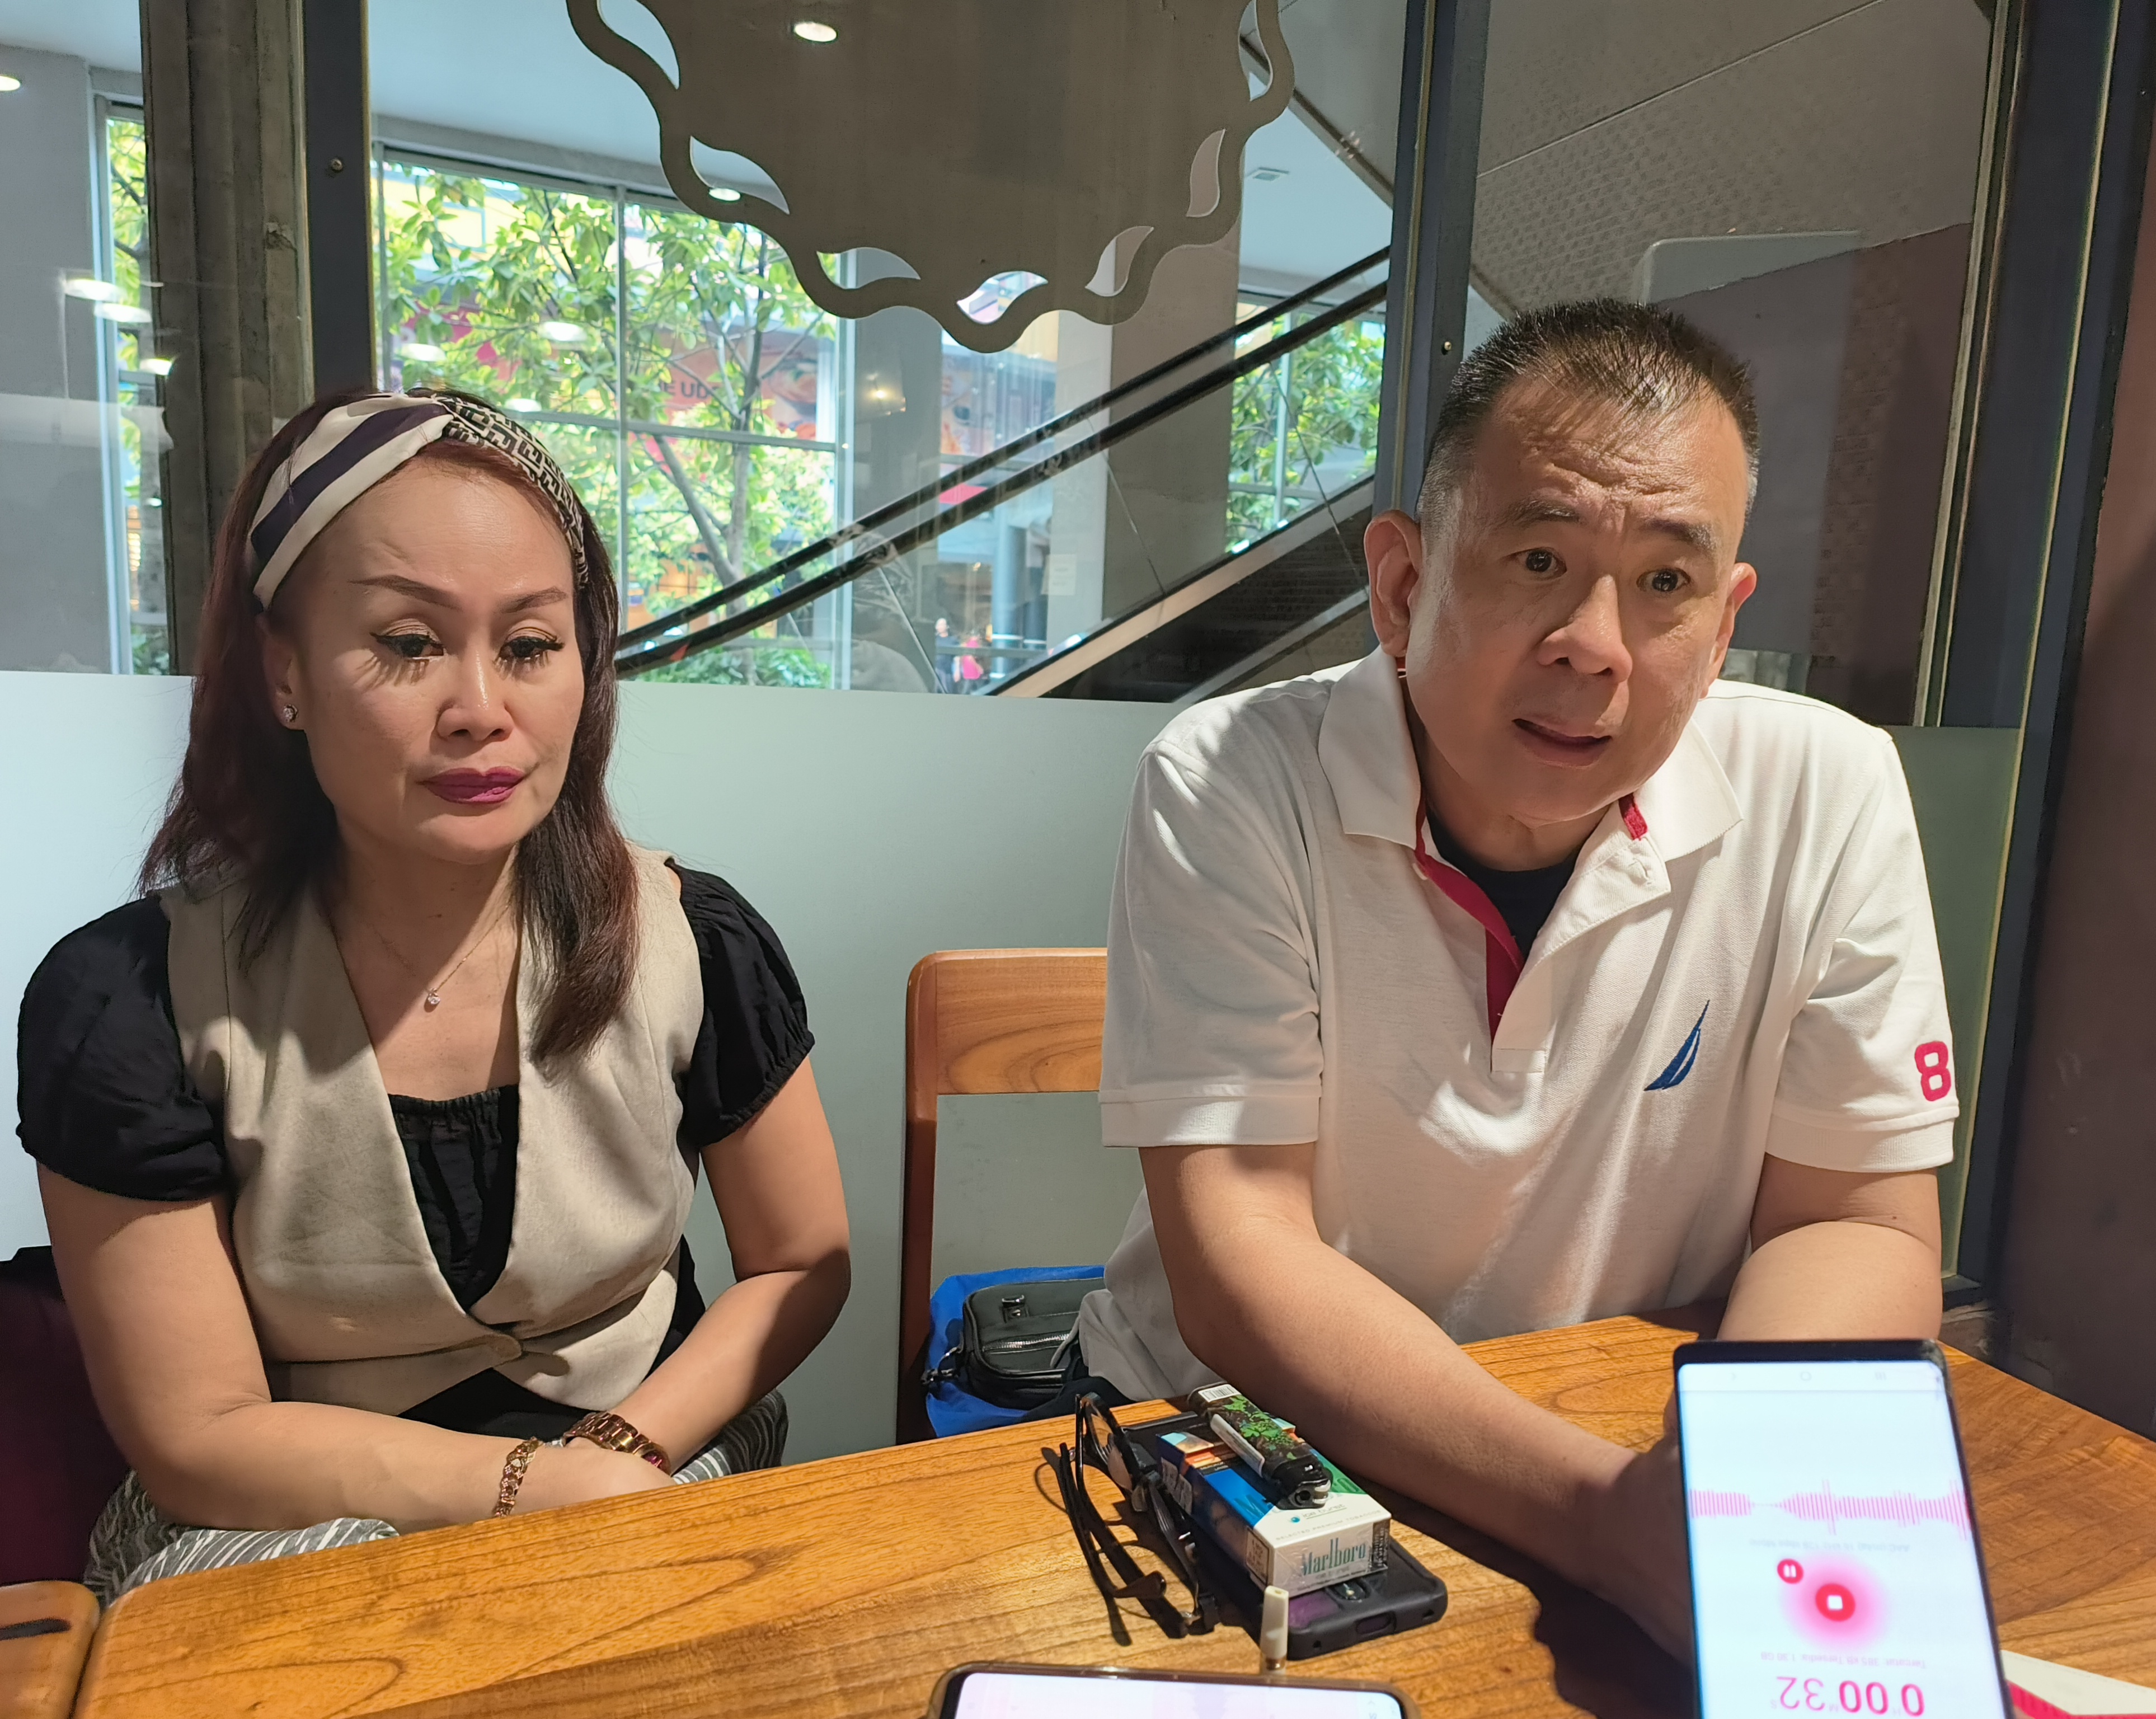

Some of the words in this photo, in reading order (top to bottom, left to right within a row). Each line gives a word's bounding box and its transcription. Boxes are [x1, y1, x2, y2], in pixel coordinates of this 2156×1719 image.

[1914, 1041, 1951, 1101] 8
[1312, 1519, 1343, 1530] PREMIUM
[1301, 1537, 1366, 1576] Marlboro
